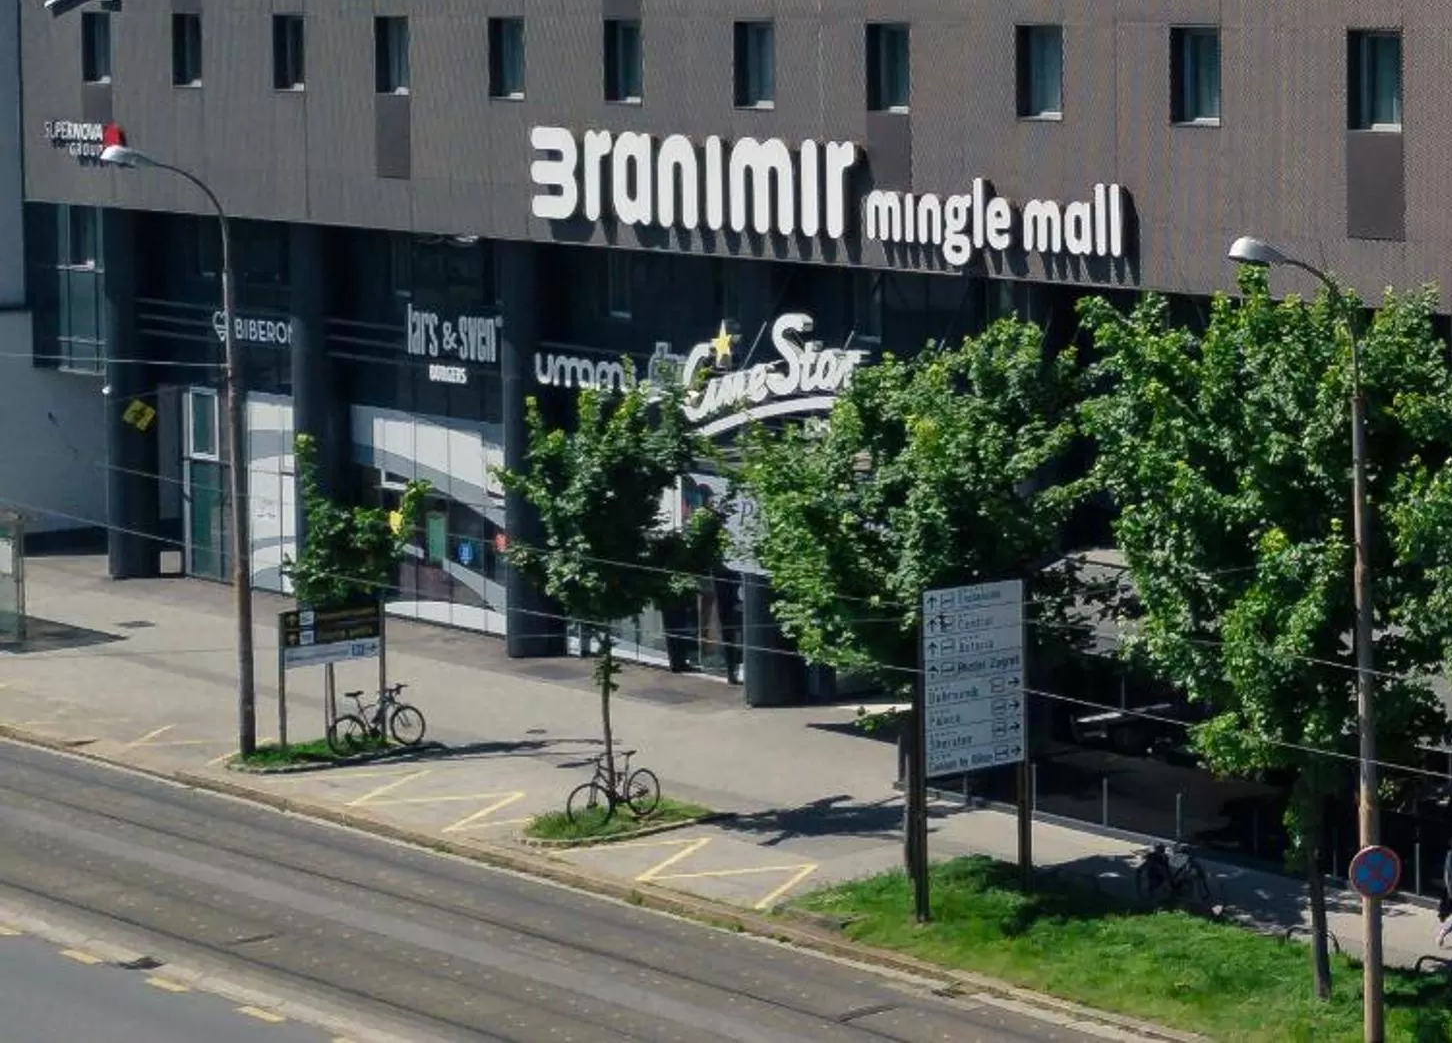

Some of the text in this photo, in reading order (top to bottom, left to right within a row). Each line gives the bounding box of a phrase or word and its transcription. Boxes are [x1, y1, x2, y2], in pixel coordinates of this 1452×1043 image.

[44, 122, 104, 142] SUPERNOVA
[866, 177, 1011, 267] mingle
[1023, 183, 1121, 257] mall
[442, 321, 458, 351] &
